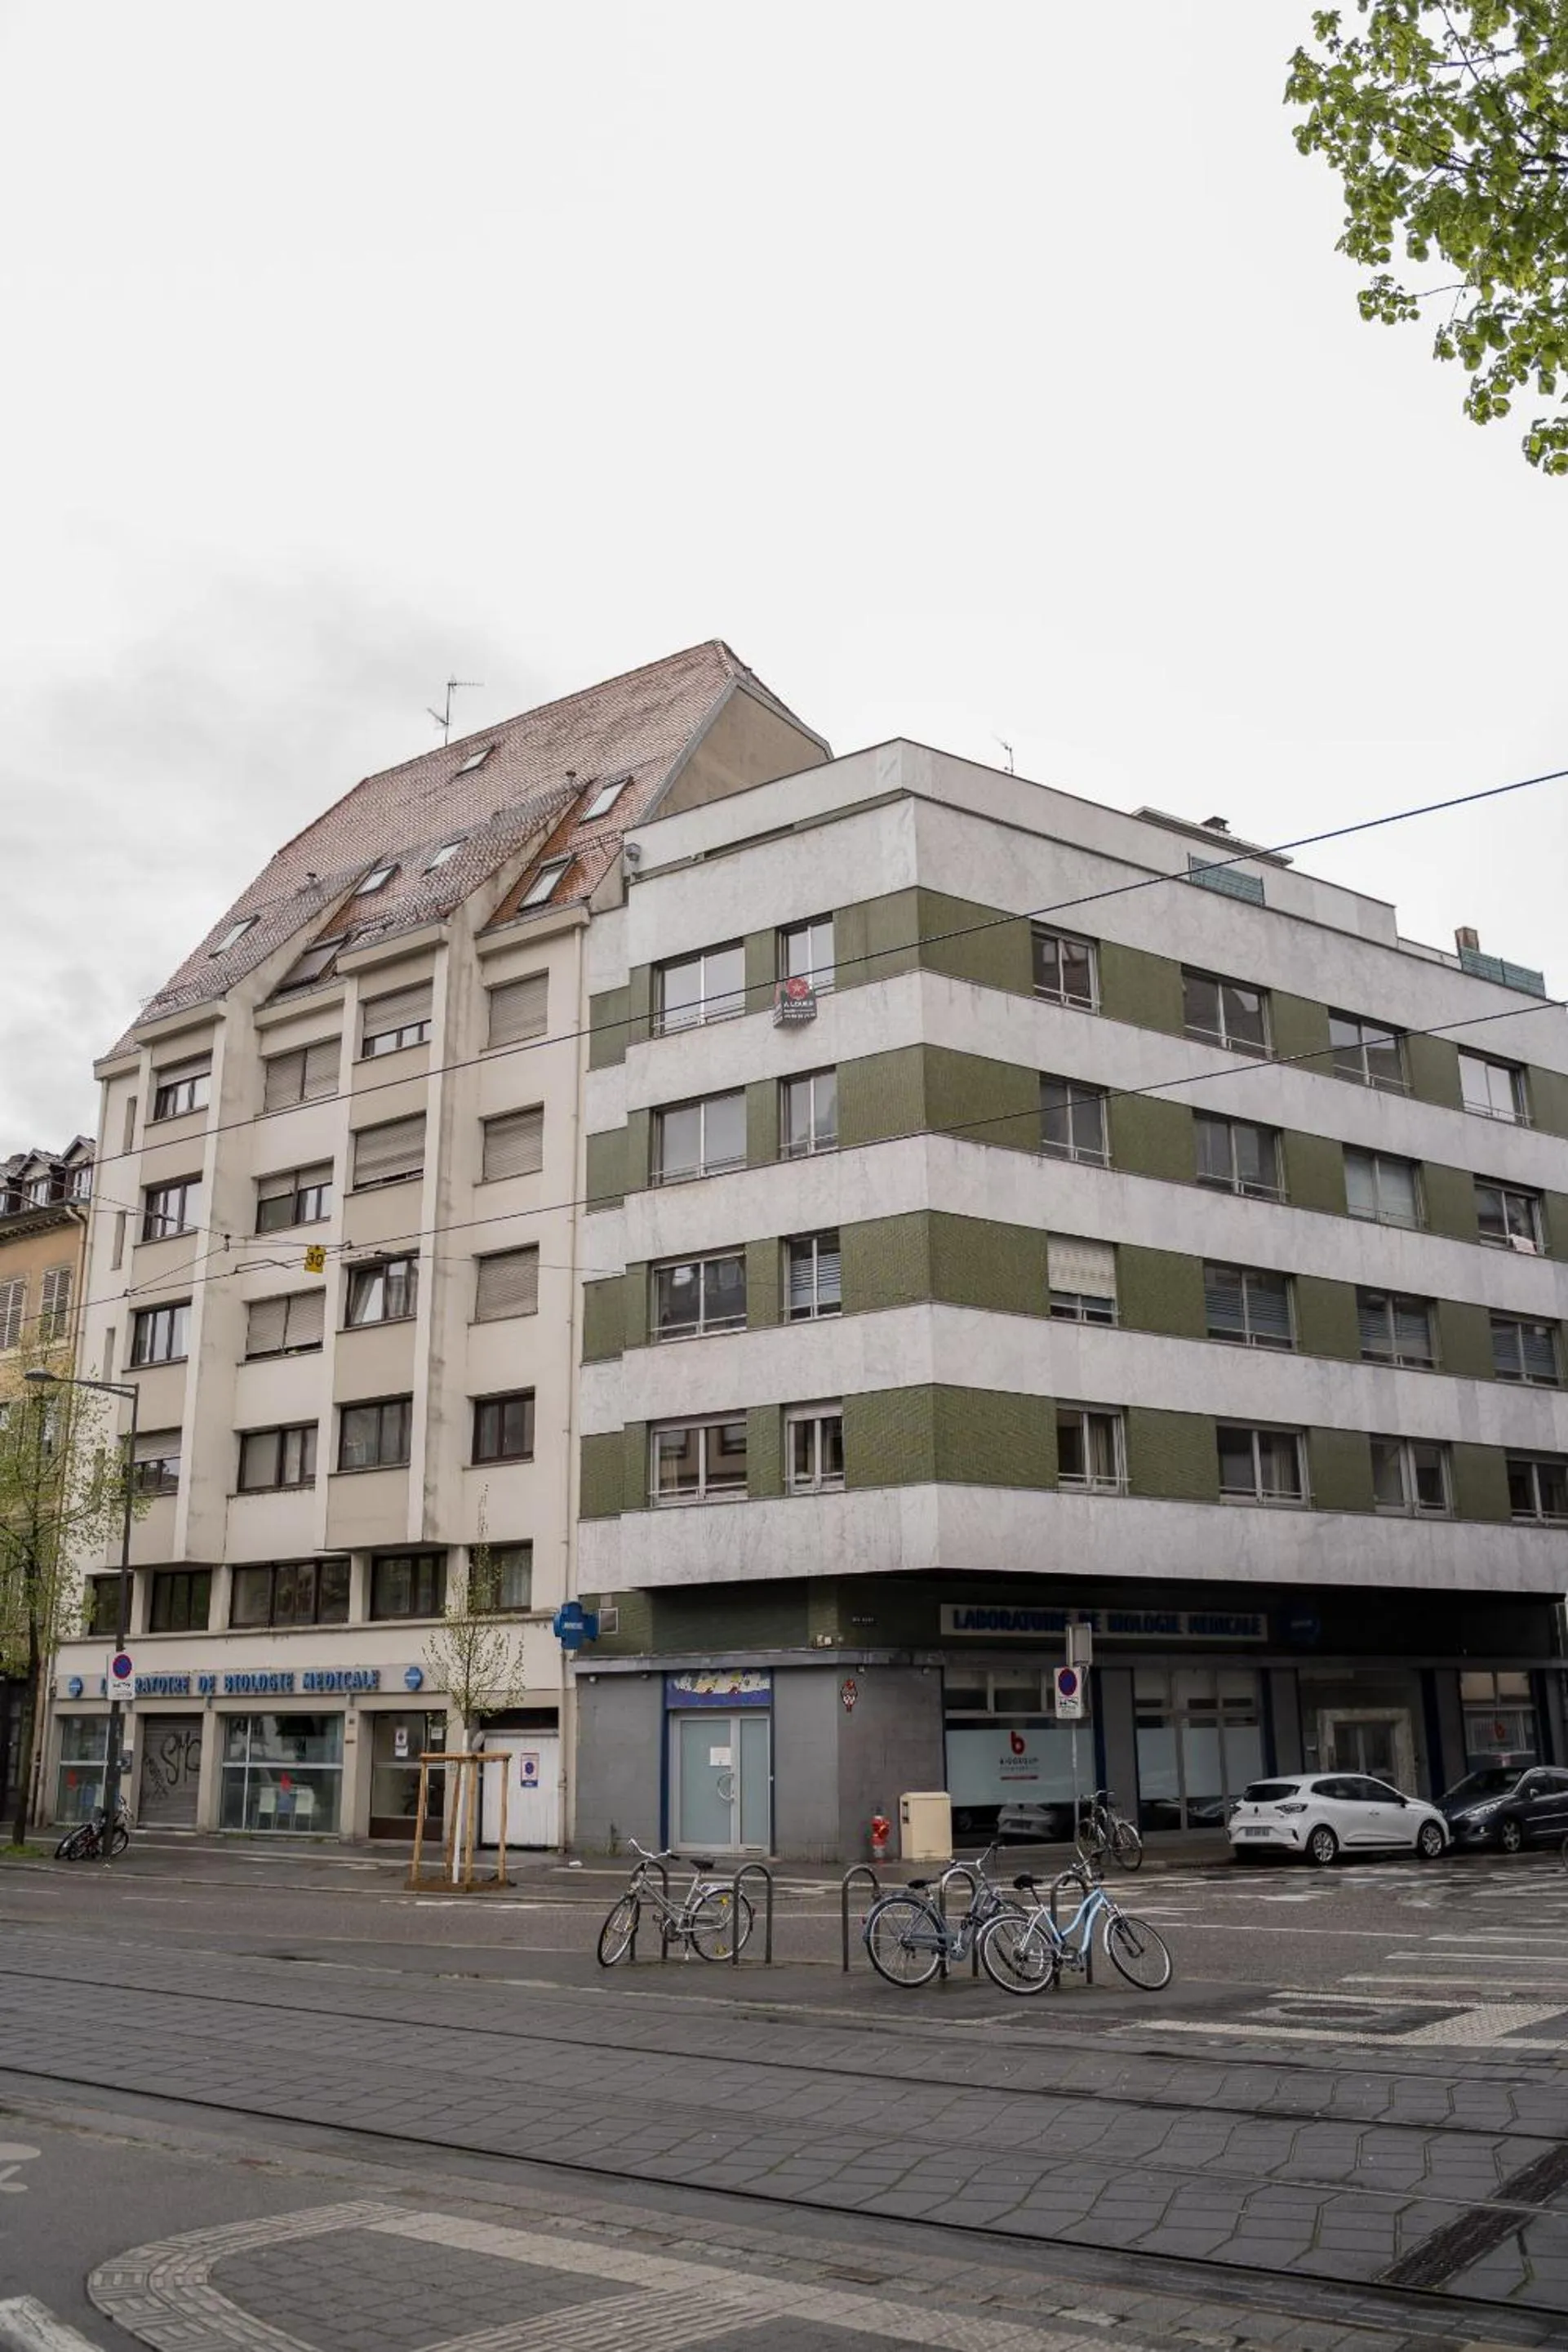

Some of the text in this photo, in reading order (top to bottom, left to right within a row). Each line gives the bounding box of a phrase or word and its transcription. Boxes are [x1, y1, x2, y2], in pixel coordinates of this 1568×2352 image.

[100, 1675, 189, 1696] LRATOIRE
[198, 1674, 216, 1695] DE
[224, 1672, 294, 1694] BIOLOGIE
